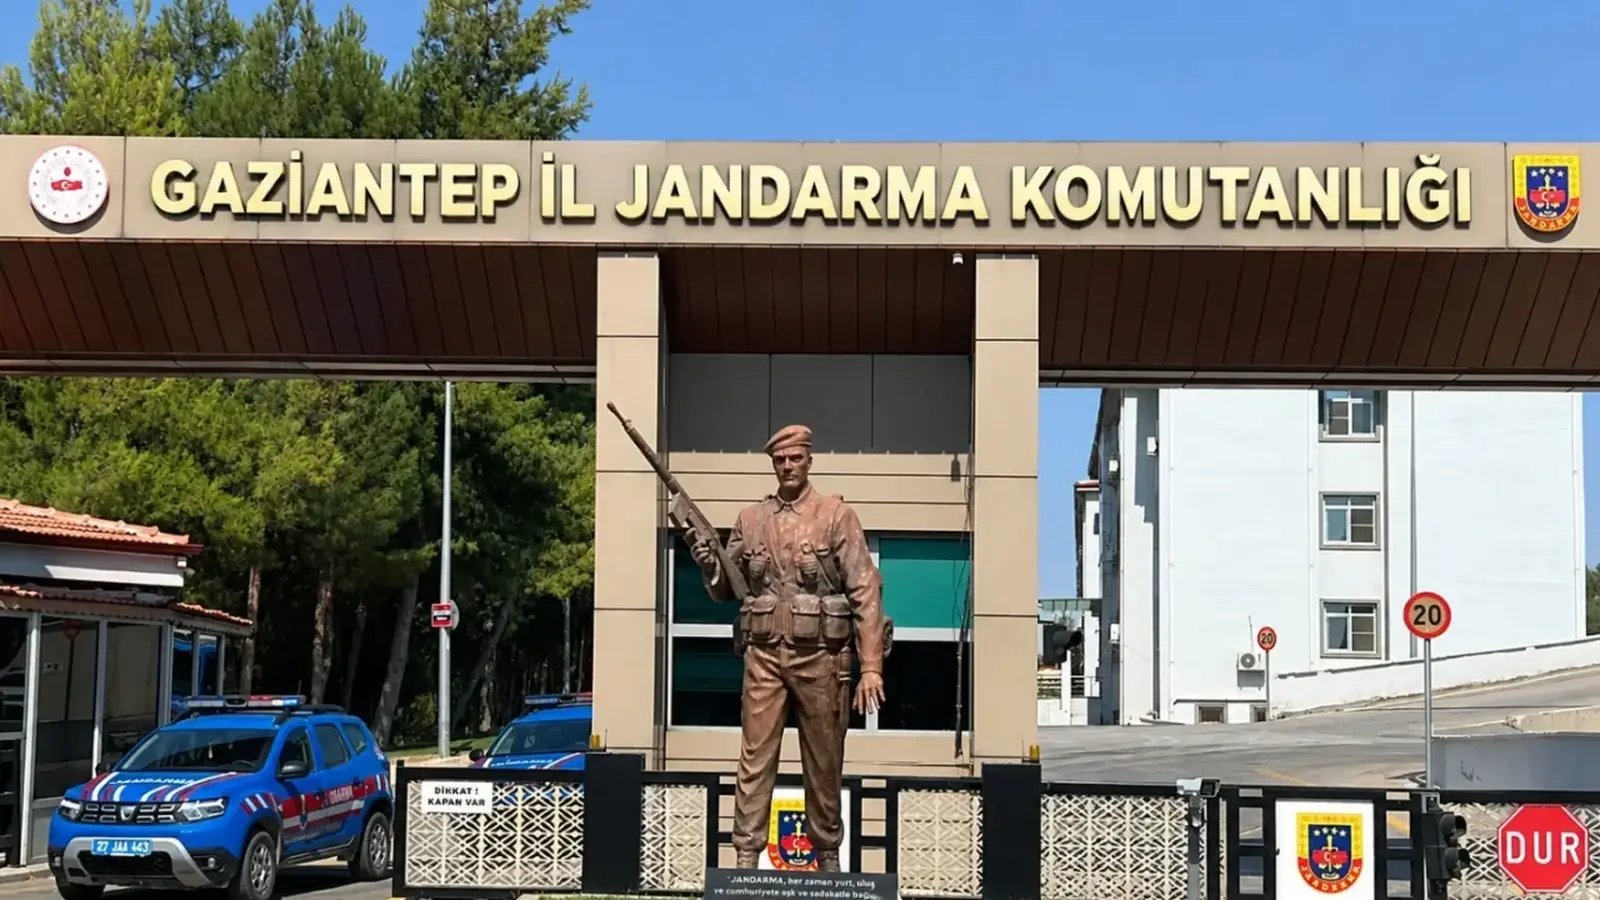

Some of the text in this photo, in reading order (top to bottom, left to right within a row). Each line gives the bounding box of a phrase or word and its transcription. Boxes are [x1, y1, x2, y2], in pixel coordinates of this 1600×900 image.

[150, 149, 520, 220] GAZİANTEP
[540, 151, 595, 220] İL
[615, 164, 990, 223] JANDARMA
[1009, 153, 1472, 227] KOMUTANLIĞI
[1413, 604, 1442, 626] 20
[1261, 632, 1273, 645] 20
[434, 785, 473, 795] DİKKAT
[427, 797, 486, 806] KAPAN VAR
[96, 841, 150, 853] 27 JAA 443
[1506, 831, 1580, 865] DUR
[788, 877, 803, 885] her
[804, 879, 833, 887] zaman
